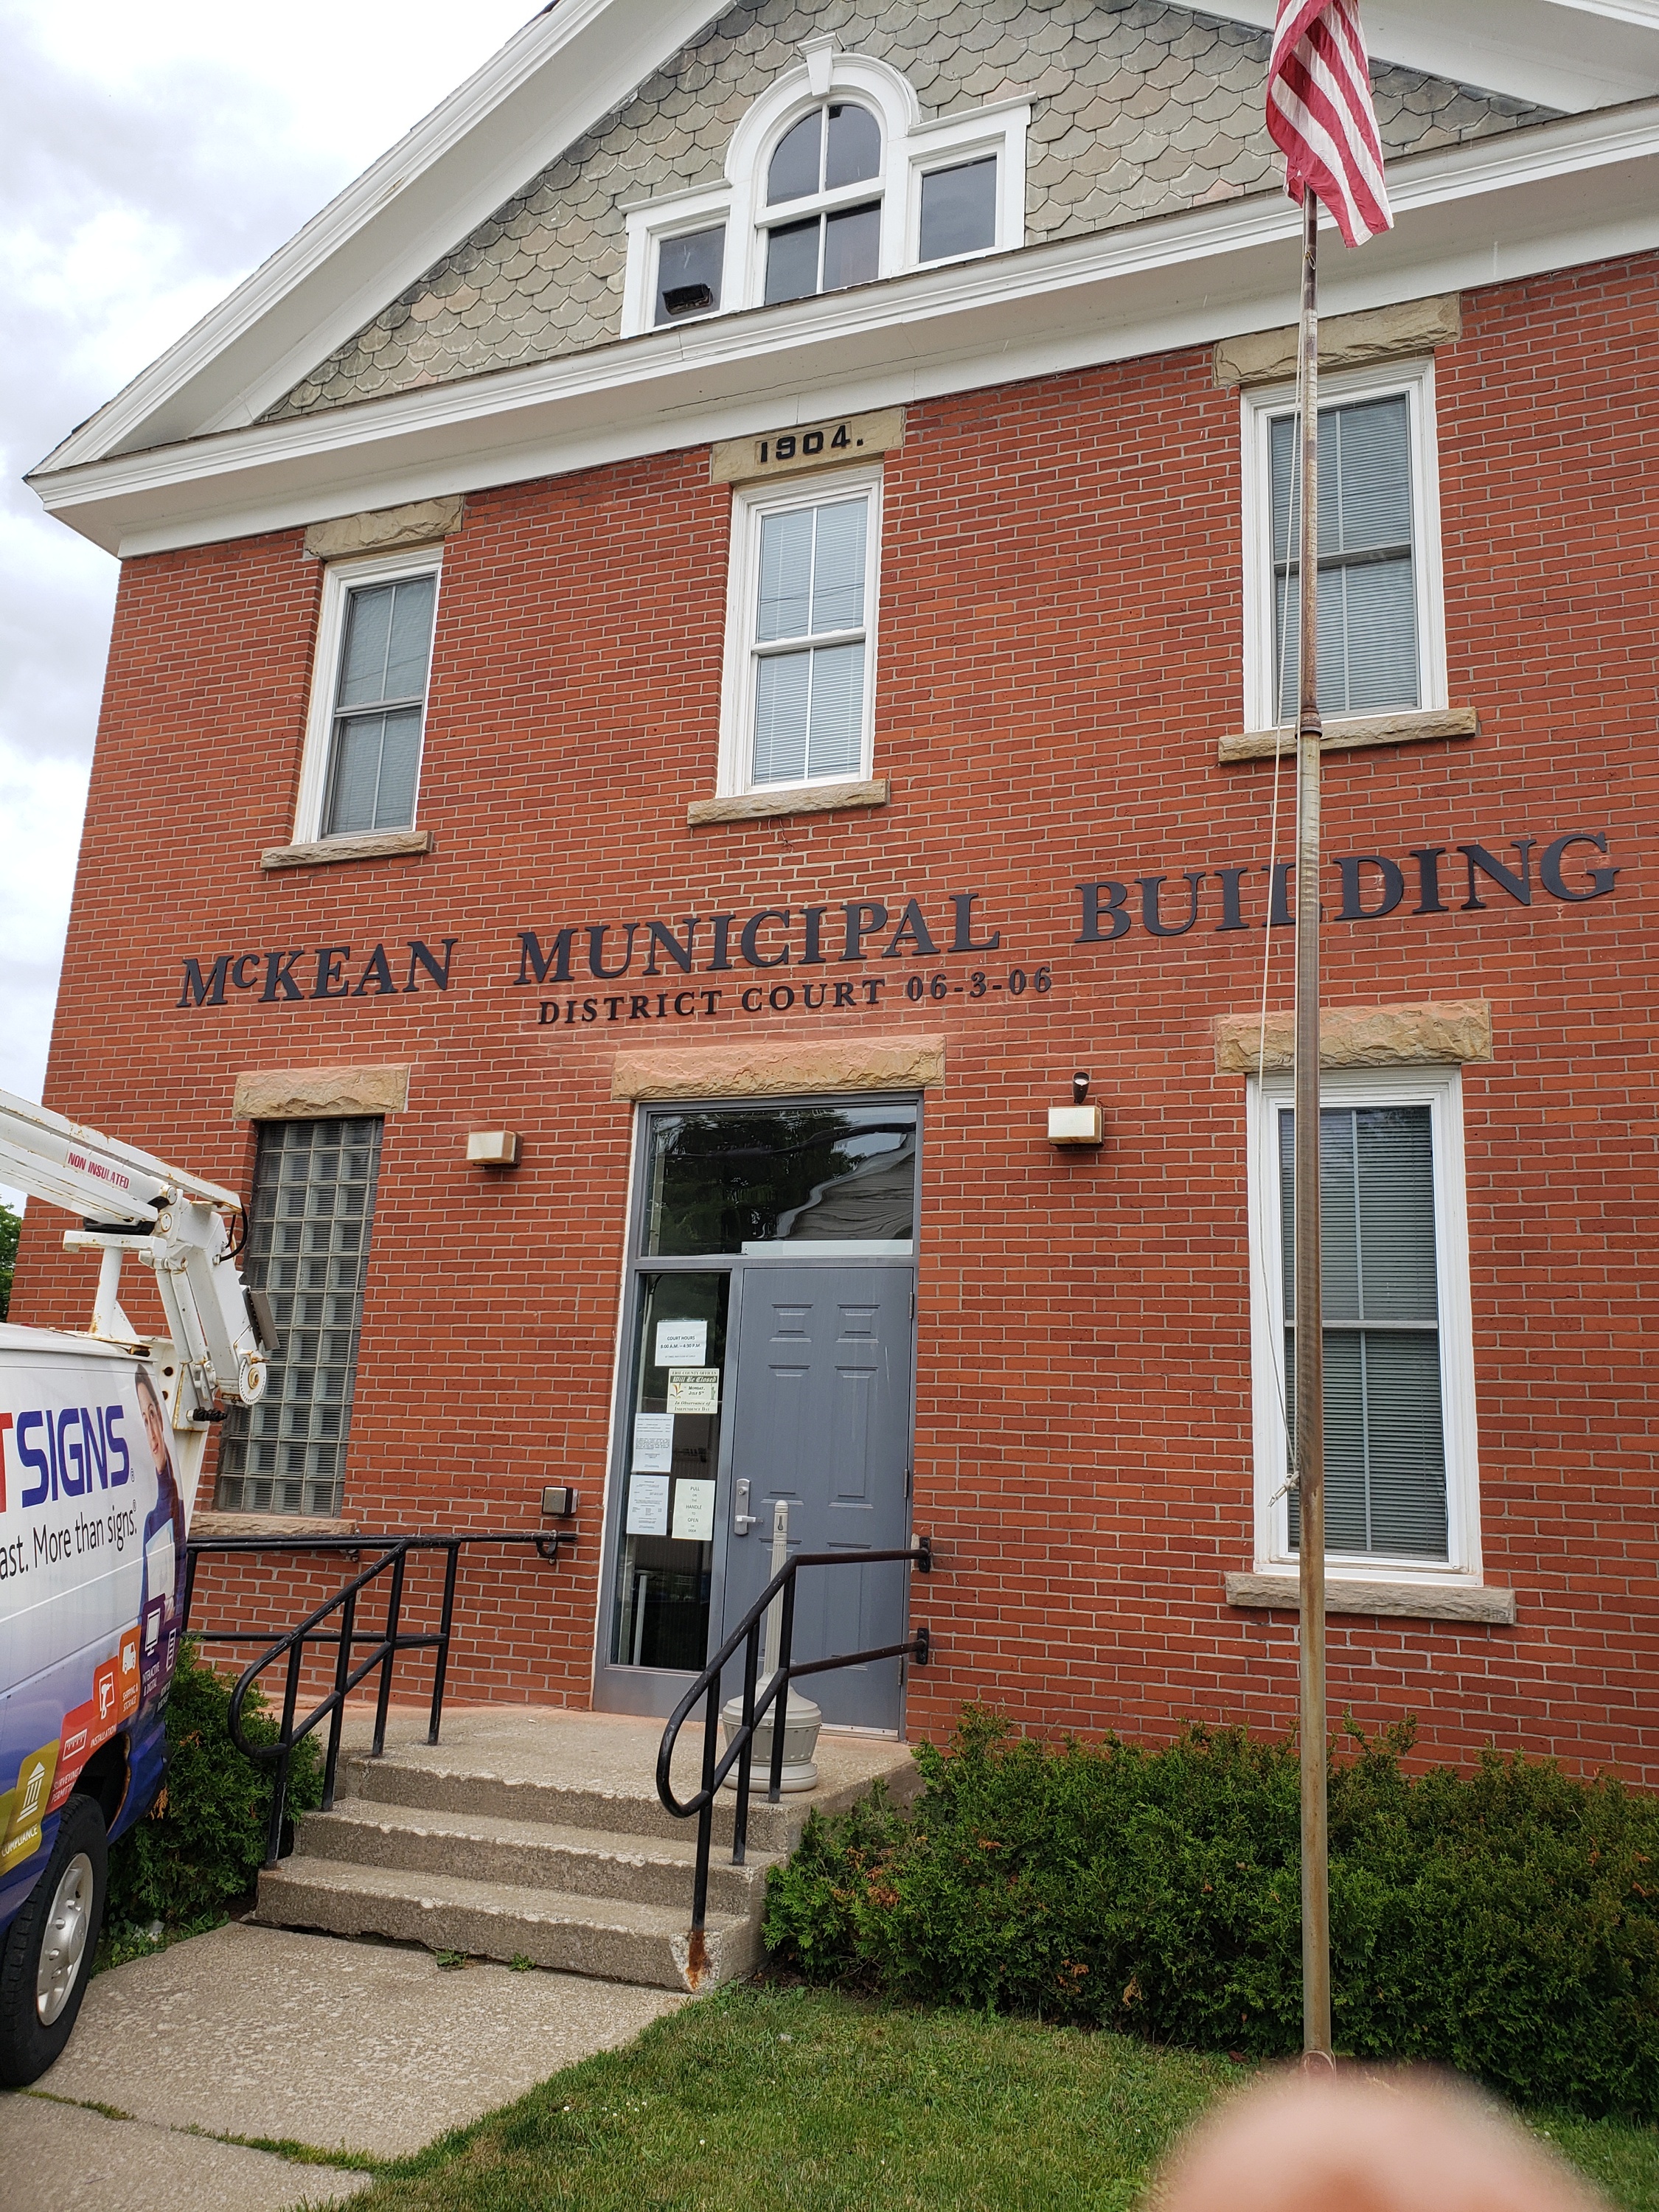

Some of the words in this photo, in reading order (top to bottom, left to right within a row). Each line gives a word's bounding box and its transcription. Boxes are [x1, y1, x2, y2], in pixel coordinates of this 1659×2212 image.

[513, 892, 1001, 985] MUNICIPAL
[538, 990, 723, 1025] DISTRICT
[742, 978, 886, 1012] COURT
[907, 966, 1052, 1001] 06-3-06
[68, 1152, 87, 1171] NON
[88, 1161, 130, 1189] INSULATED
[33, 1524, 72, 1568] More
[75, 1512, 104, 1554] than
[1, 1823, 38, 1857] COMPLIANCE
